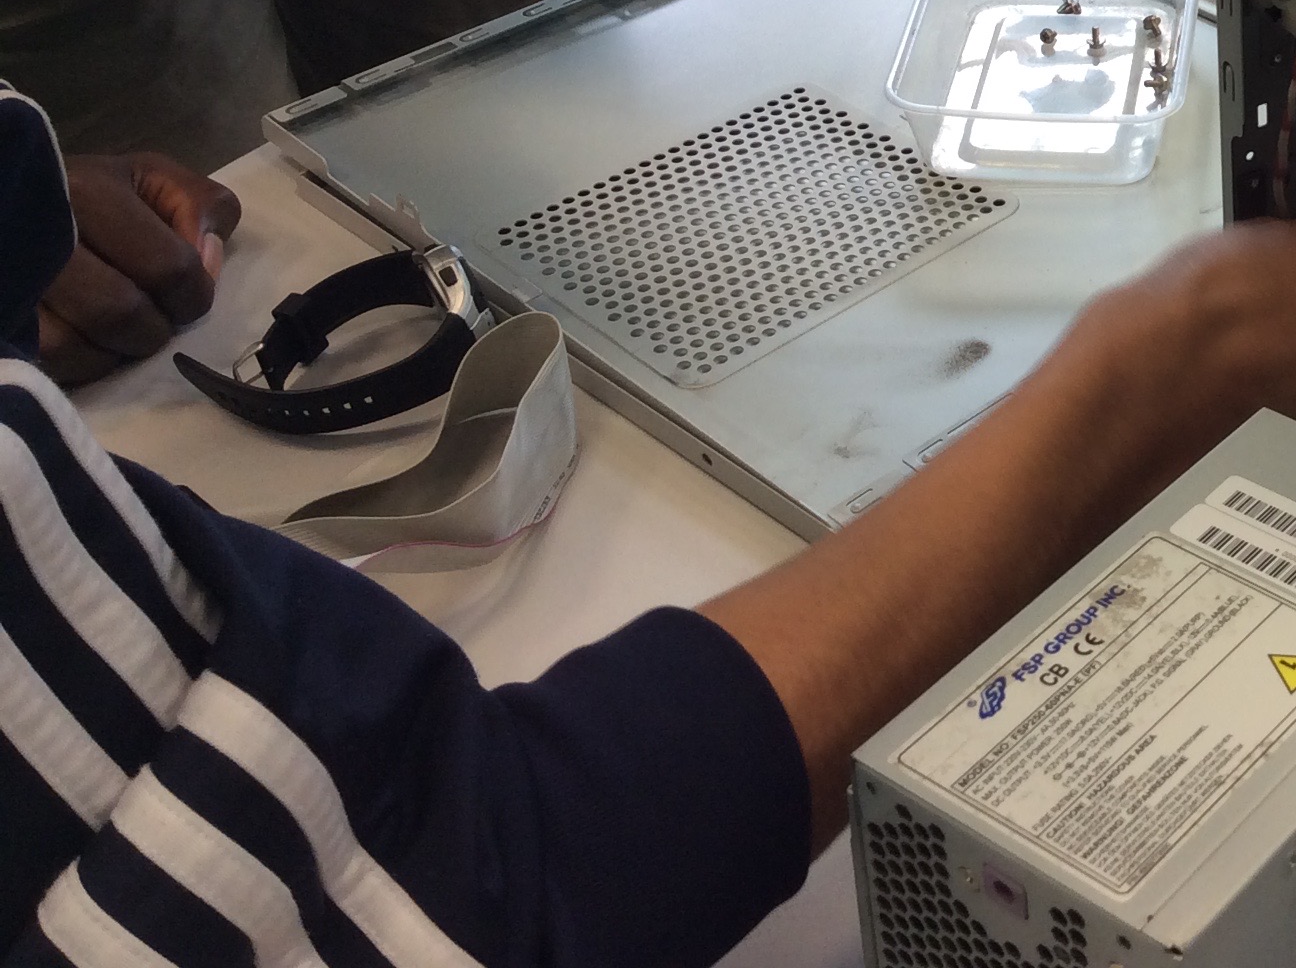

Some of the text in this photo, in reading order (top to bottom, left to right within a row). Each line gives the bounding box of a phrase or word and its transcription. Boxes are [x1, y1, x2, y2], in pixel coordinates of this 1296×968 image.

[1009, 578, 1133, 683] FSP GROUP INC.
[1036, 661, 1071, 688] CB
[956, 754, 996, 788] MODEL
